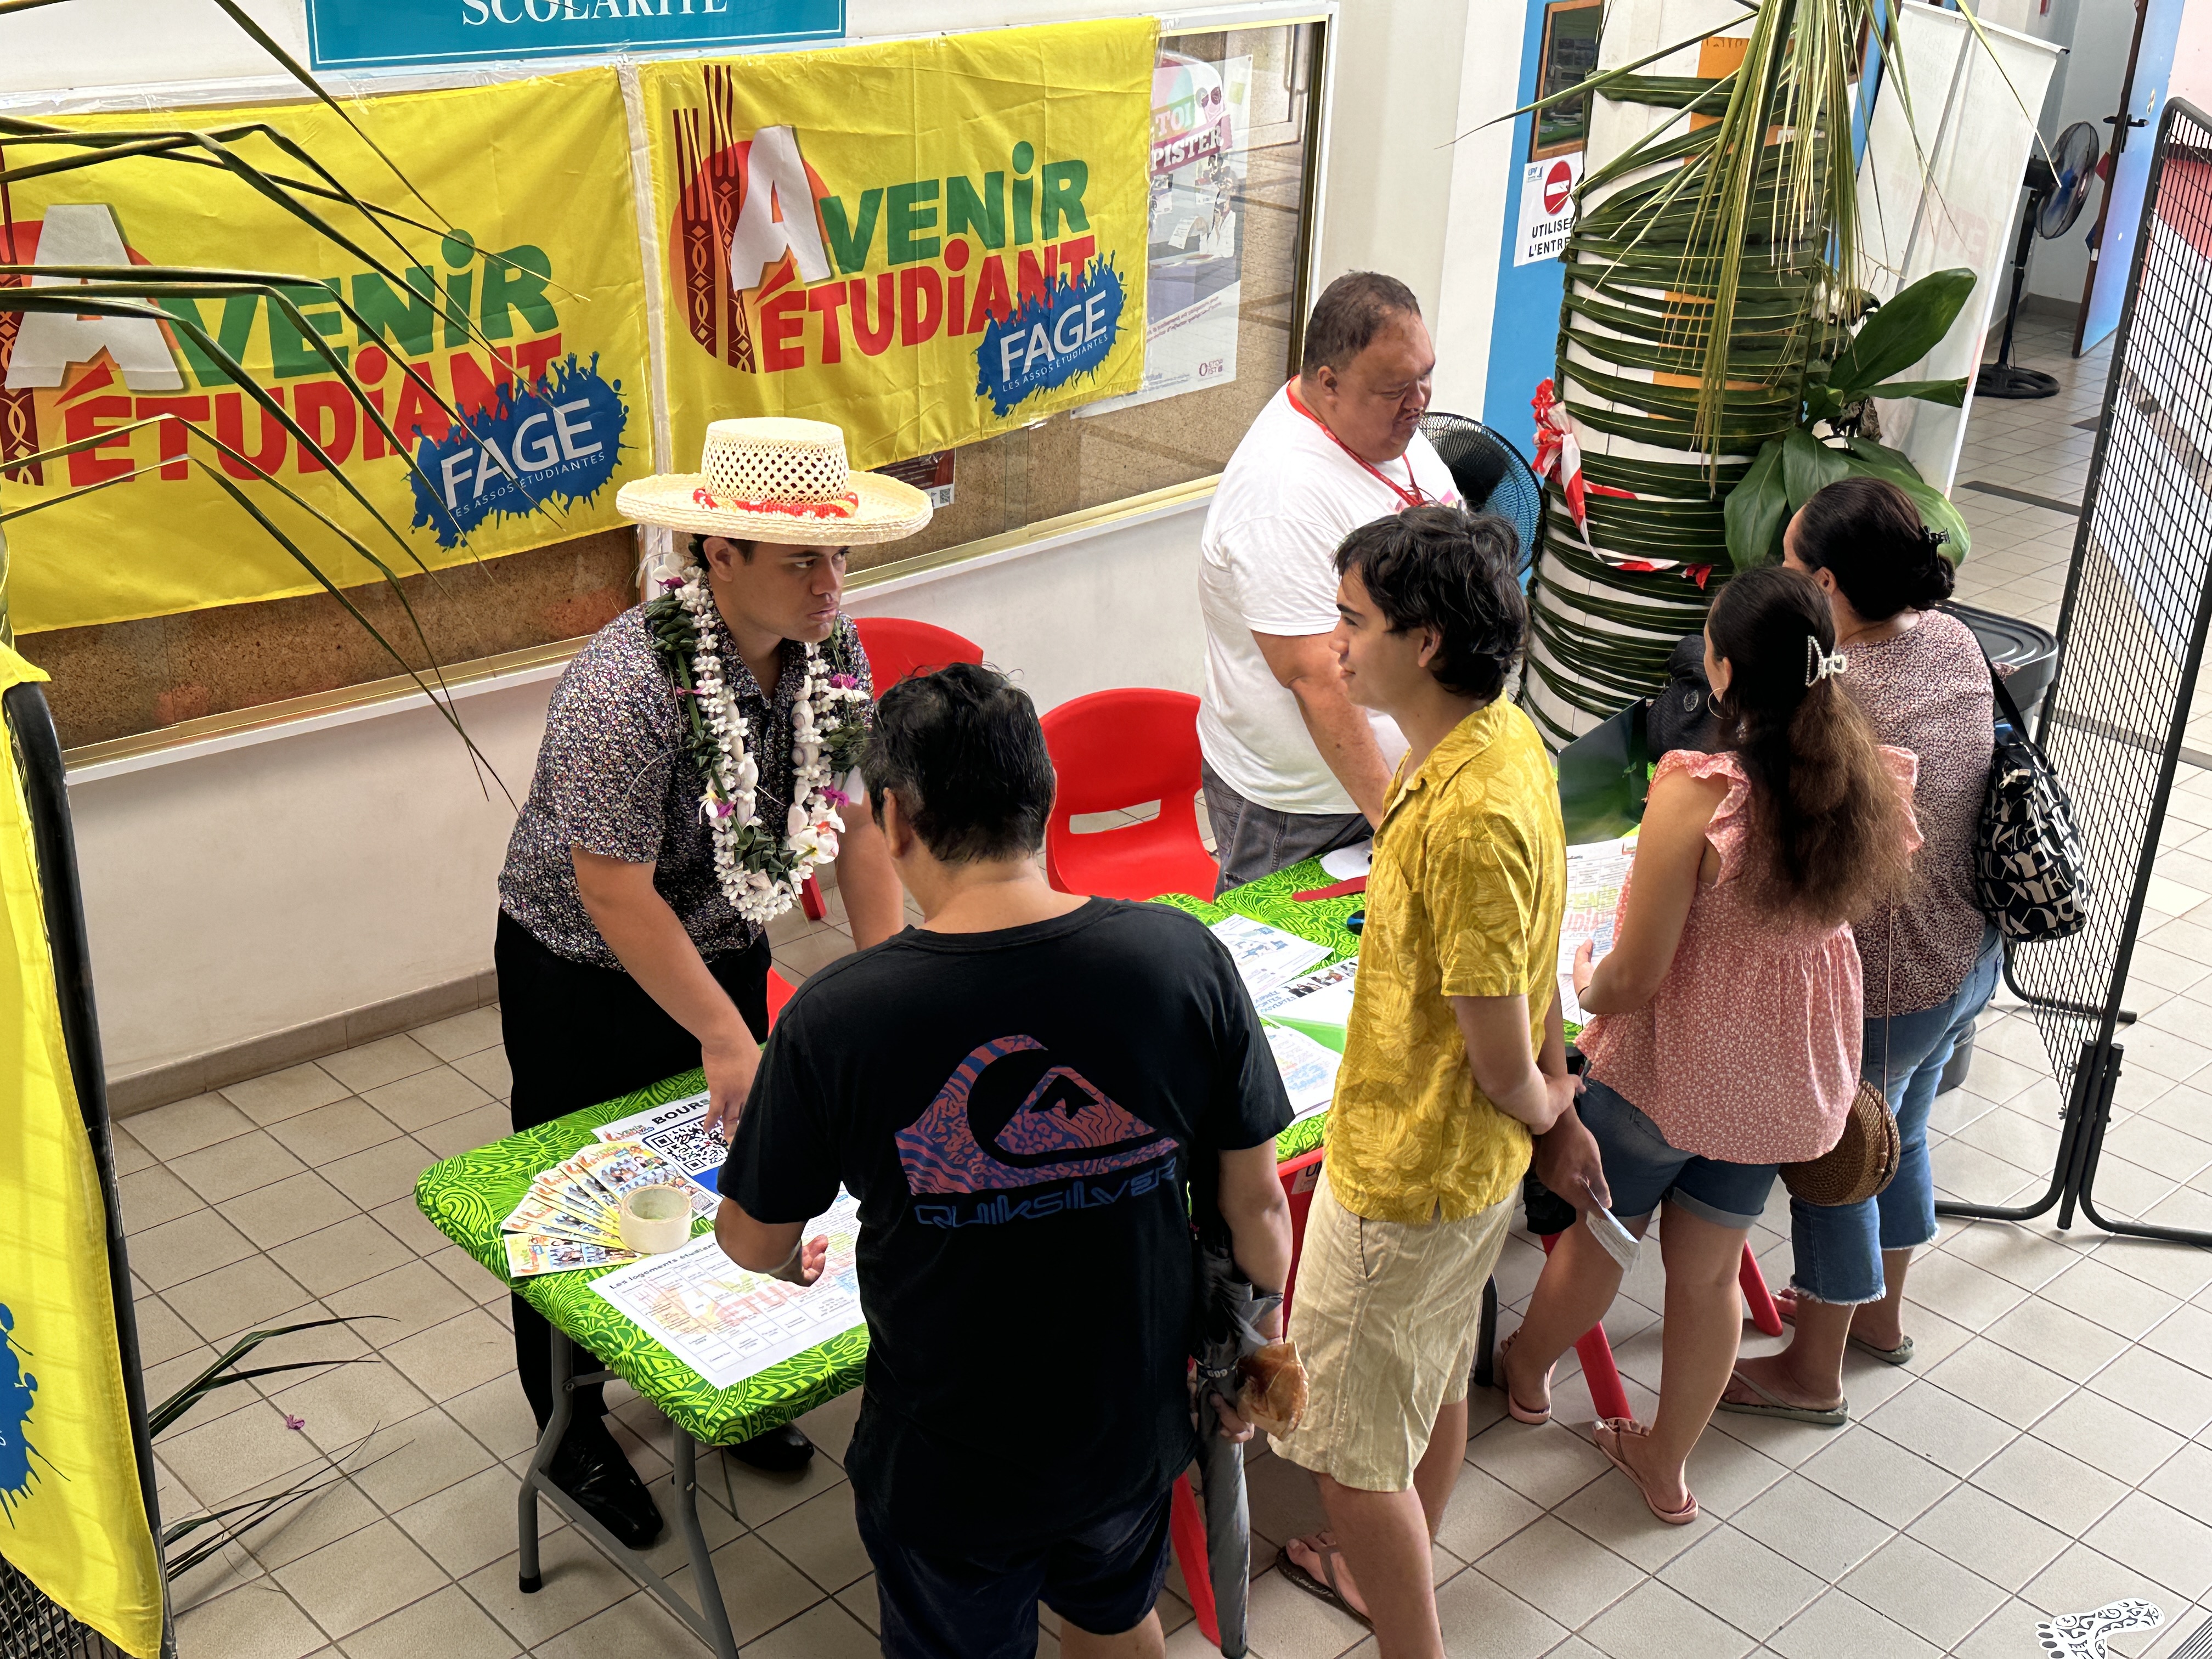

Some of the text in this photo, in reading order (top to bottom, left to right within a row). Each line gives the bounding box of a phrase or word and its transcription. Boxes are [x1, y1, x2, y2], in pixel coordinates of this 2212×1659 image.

[1000, 290, 1107, 383] FAGE
[1002, 333, 1109, 392] LES ASSOS ÉTUDIANTES
[441, 398, 603, 511] FAGE
[474, 483, 515, 509] ASSOS
[609, 1280, 628, 1289] Les
[628, 1257, 678, 1281] logements
